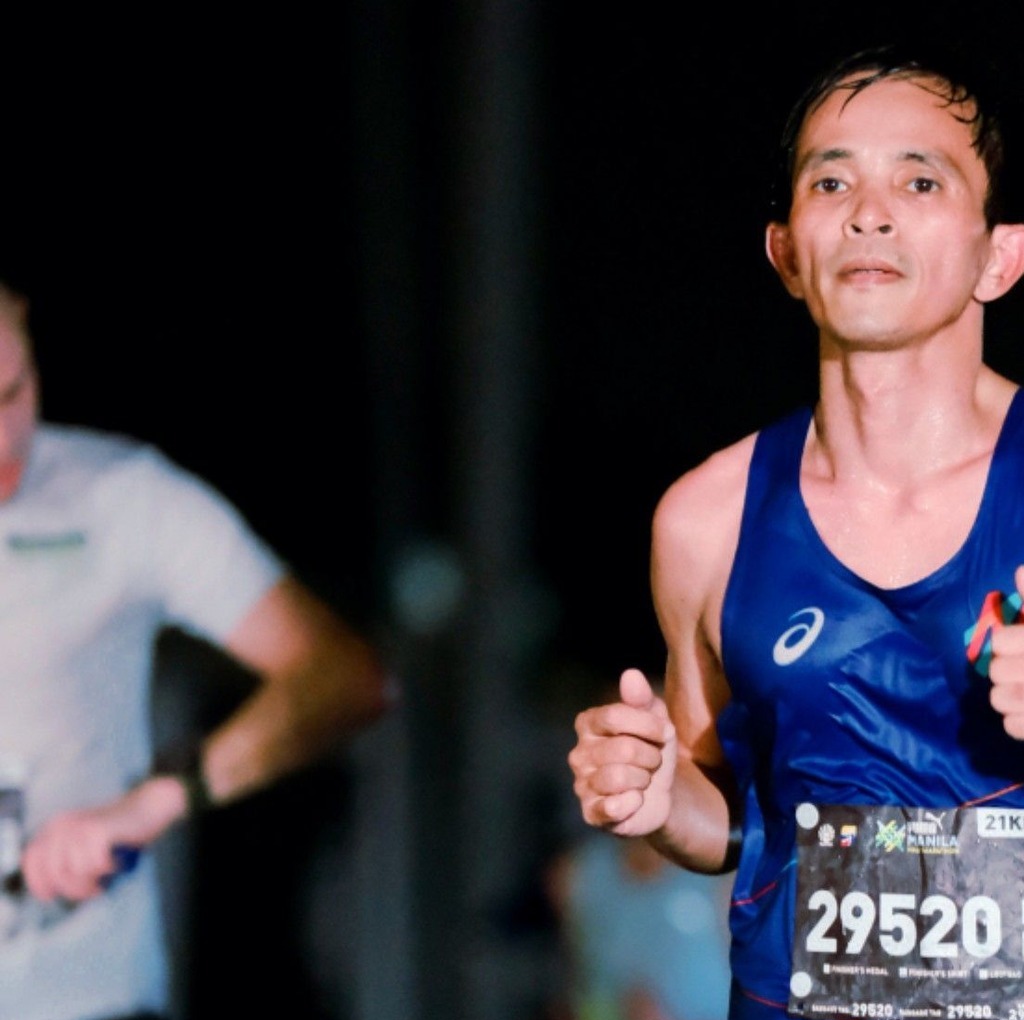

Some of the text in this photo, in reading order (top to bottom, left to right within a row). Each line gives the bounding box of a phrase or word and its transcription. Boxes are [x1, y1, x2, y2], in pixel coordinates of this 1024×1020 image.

[908, 834, 958, 847] MANILA
[806, 890, 1001, 958] 29520
[851, 1002, 893, 1017] 29520
[947, 1004, 992, 1020] 29520
